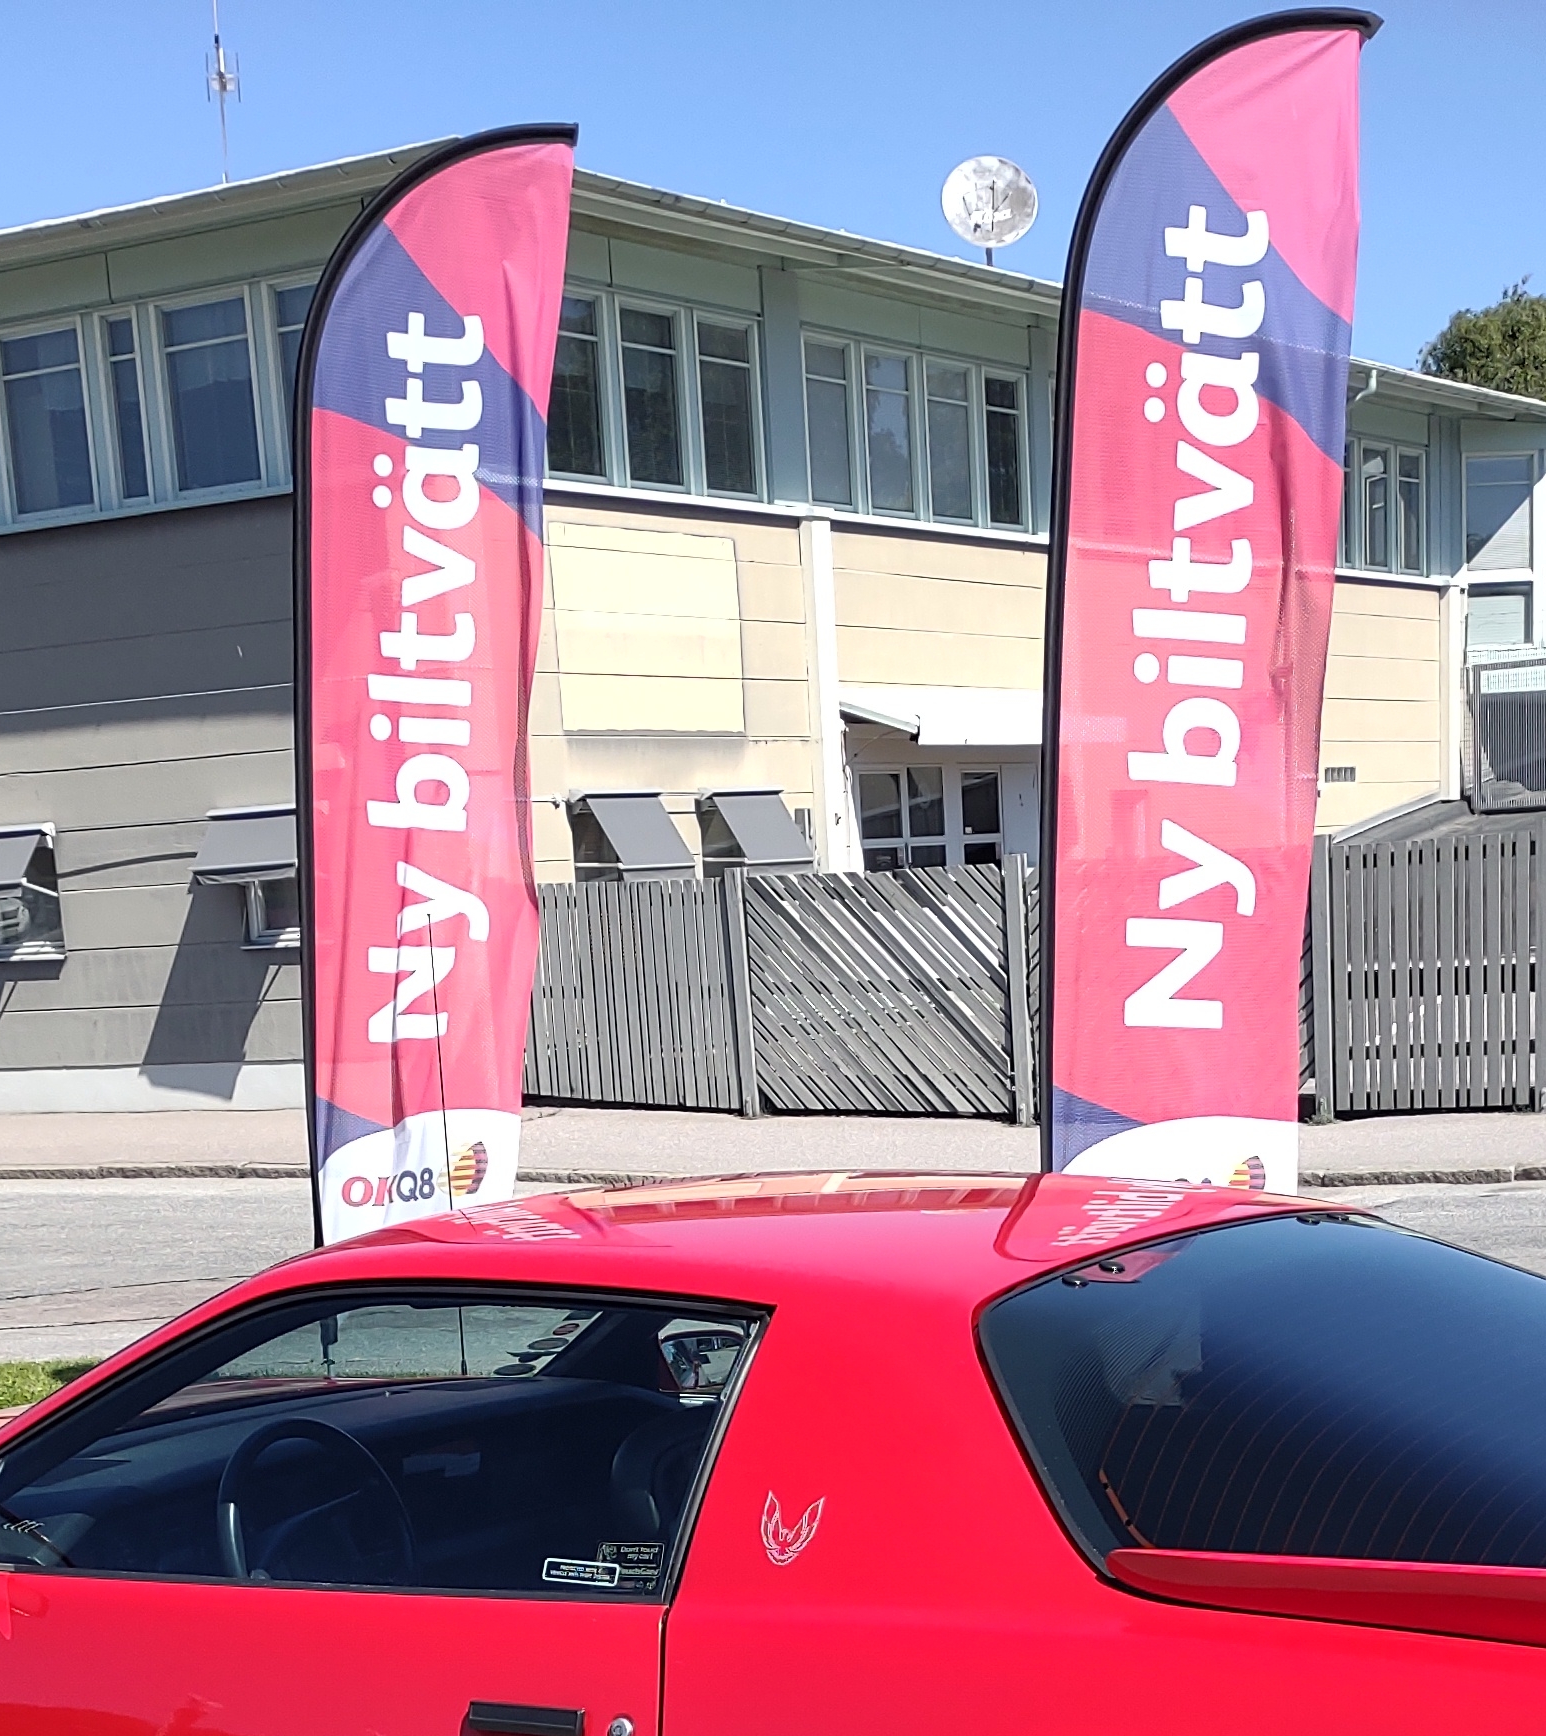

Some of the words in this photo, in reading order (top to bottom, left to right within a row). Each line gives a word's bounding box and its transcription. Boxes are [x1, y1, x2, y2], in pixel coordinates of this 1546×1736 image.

[366, 311, 485, 832] biltvätt
[1127, 204, 1271, 787] biltvätt
[367, 861, 490, 1045] Ny
[1123, 818, 1256, 1030] Ny
